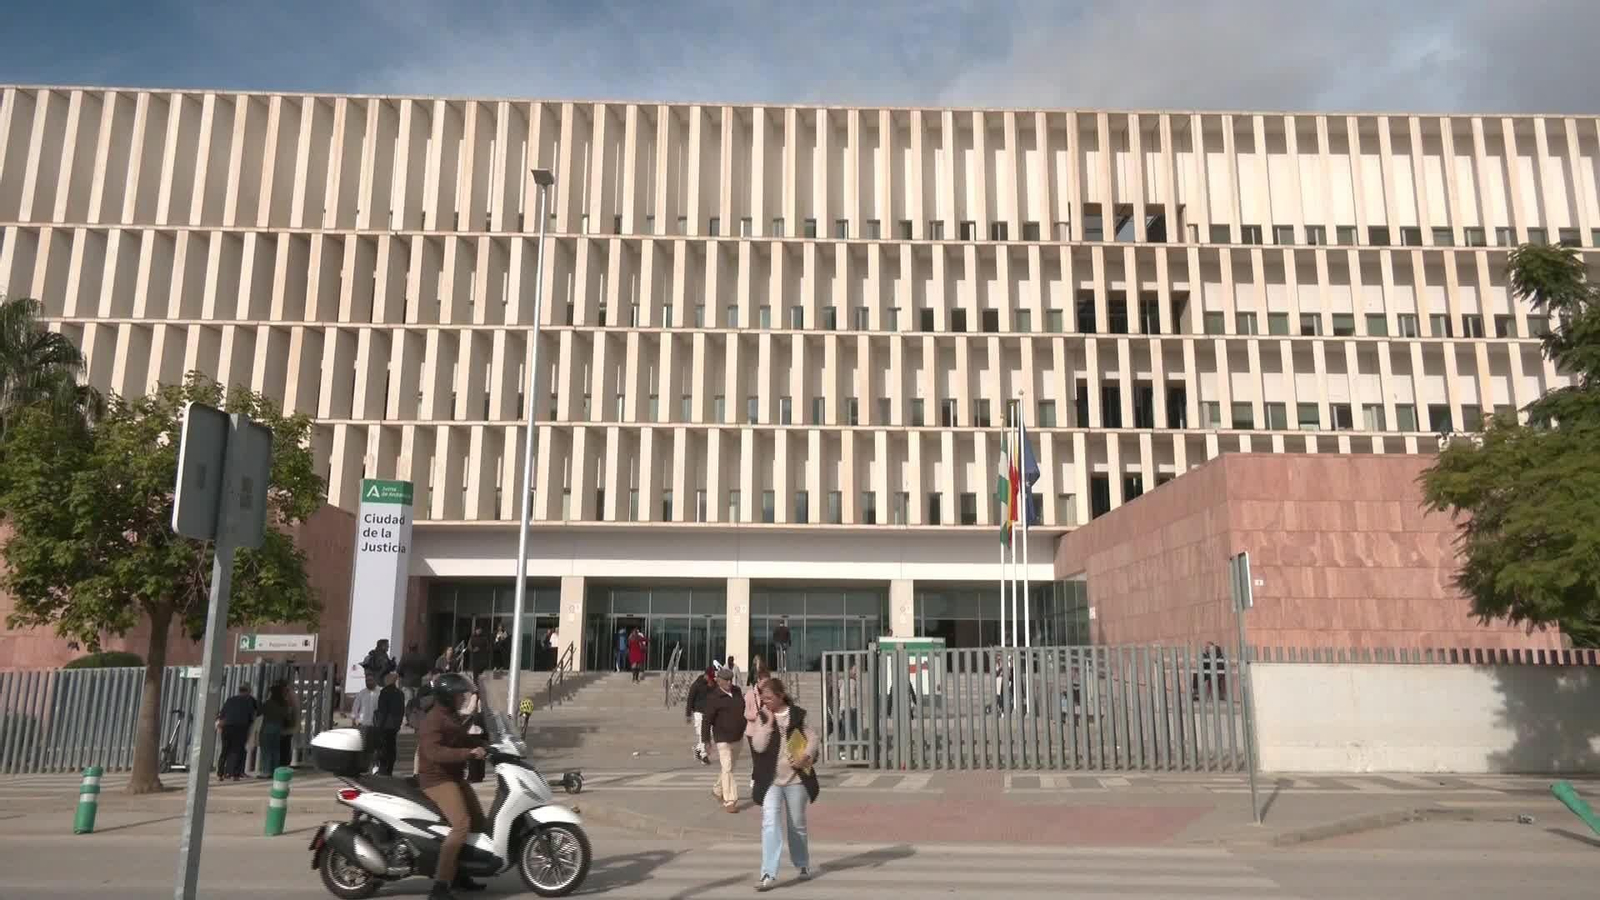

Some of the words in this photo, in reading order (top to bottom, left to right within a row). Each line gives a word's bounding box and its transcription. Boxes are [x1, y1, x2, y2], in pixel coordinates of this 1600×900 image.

[364, 513, 405, 525] Ciudad
[362, 527, 378, 538] de
[381, 527, 392, 538] la
[361, 541, 406, 554] Justicia
